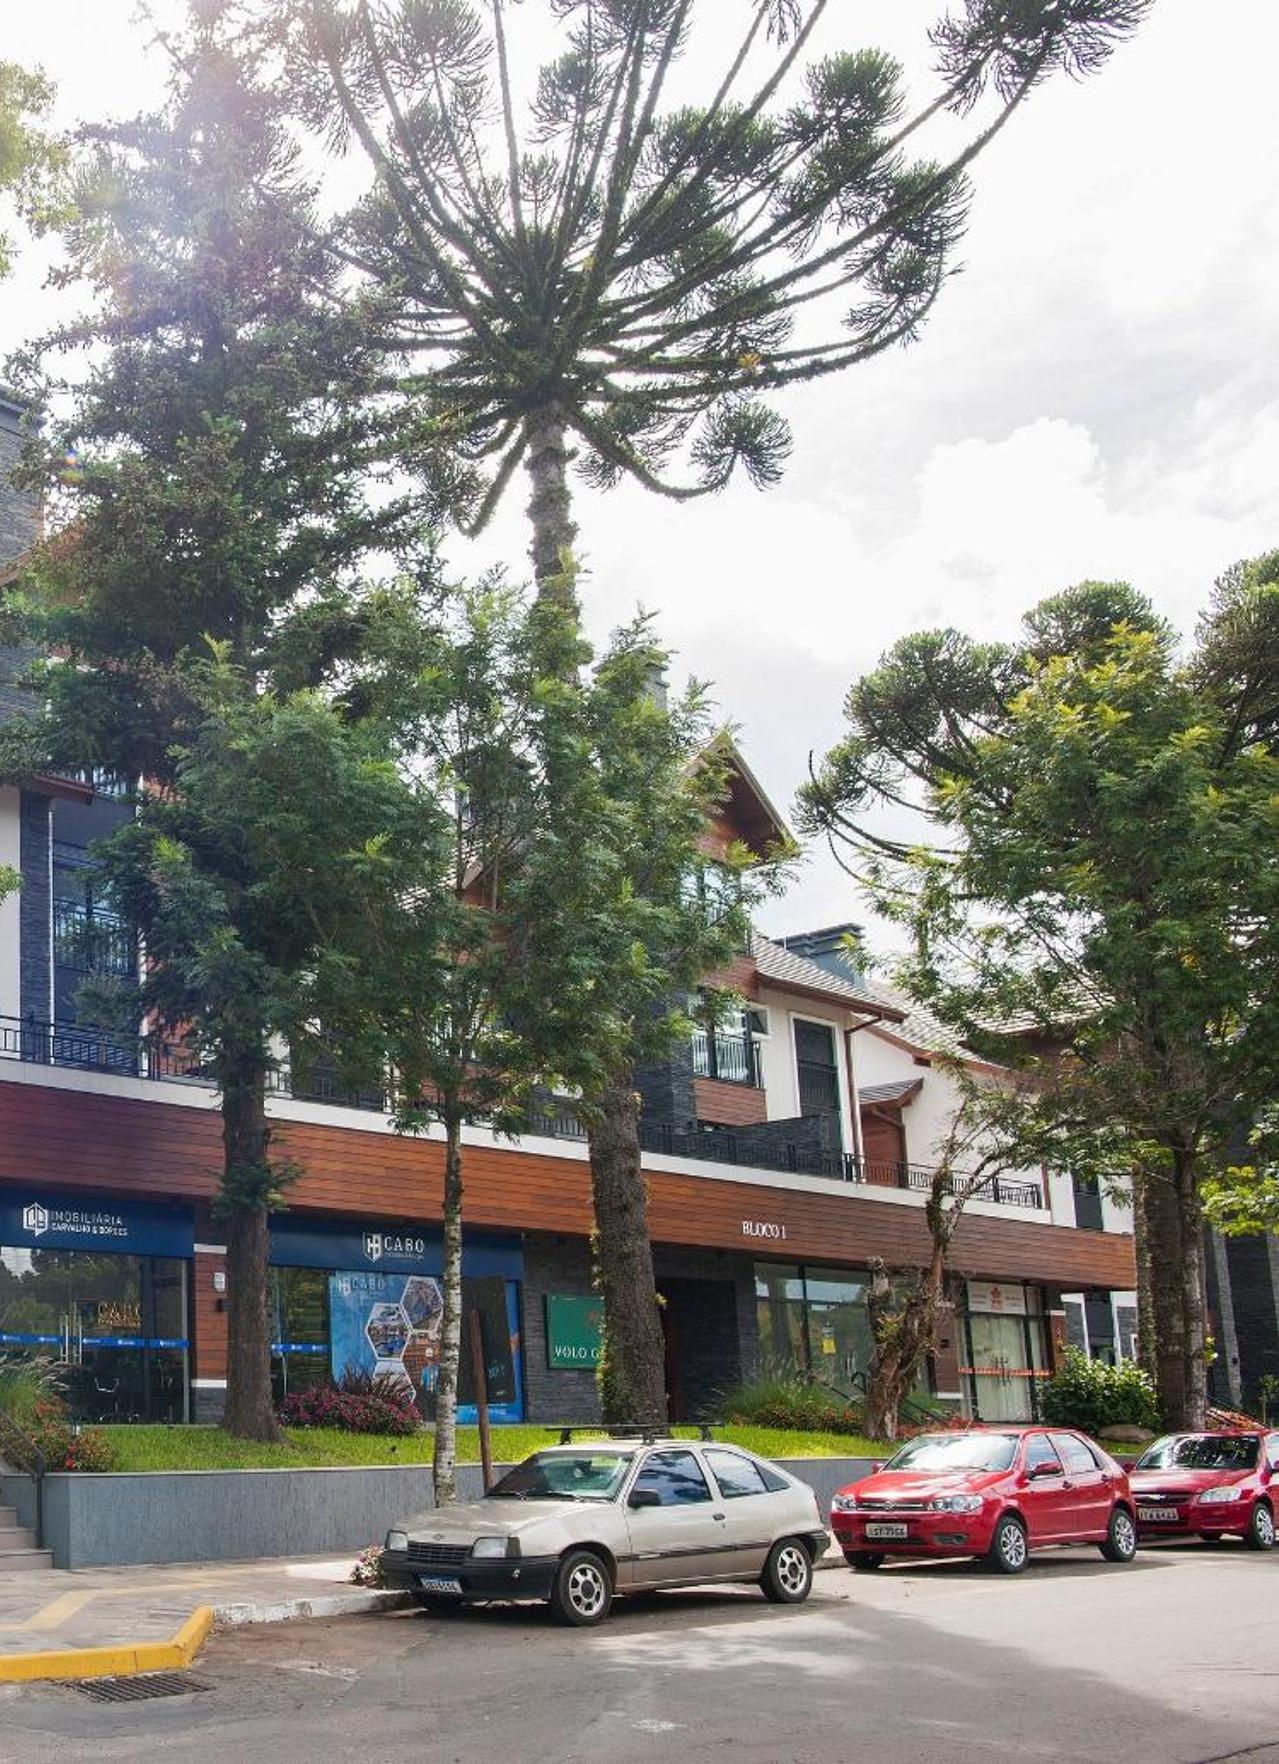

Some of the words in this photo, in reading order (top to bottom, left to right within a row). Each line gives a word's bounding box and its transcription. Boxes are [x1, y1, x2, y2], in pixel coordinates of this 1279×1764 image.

[742, 1220, 780, 1238] BLOCO
[781, 1224, 787, 1239] 1
[555, 1345, 587, 1359] VOLO
